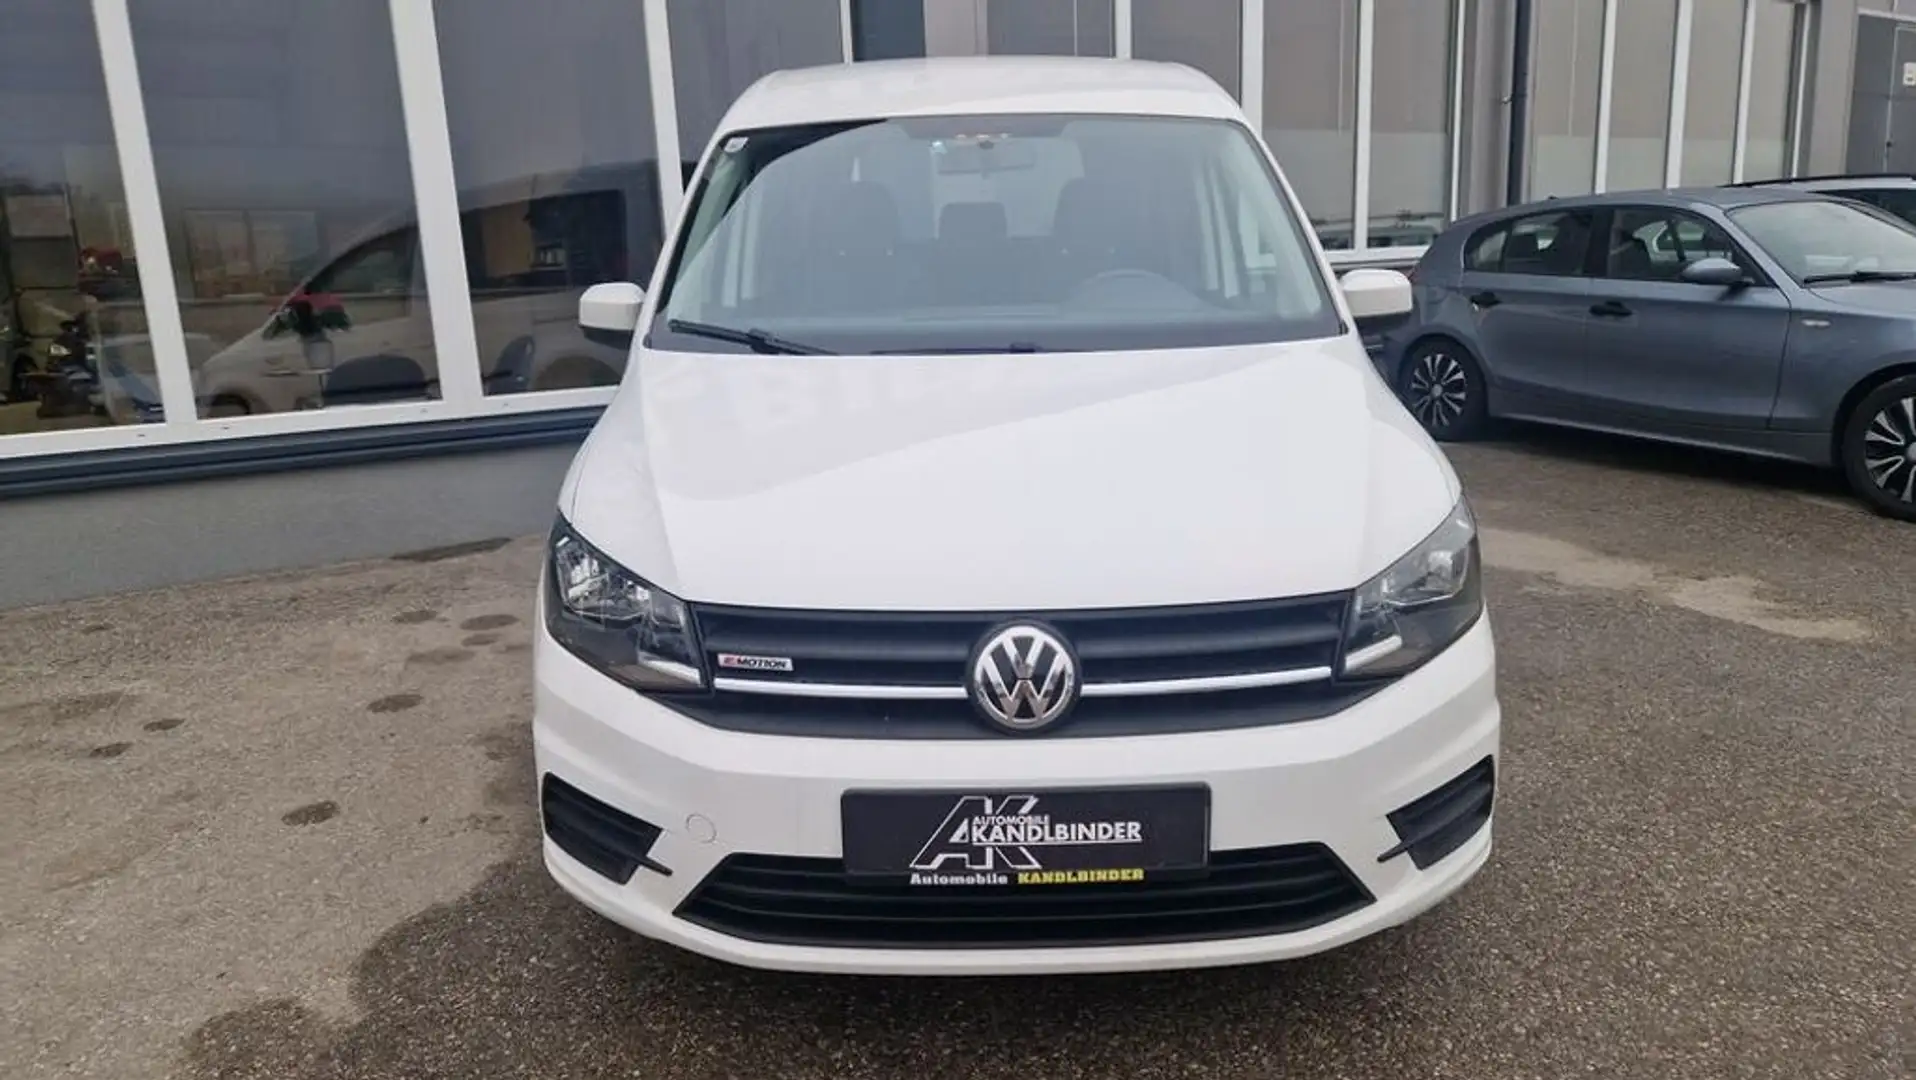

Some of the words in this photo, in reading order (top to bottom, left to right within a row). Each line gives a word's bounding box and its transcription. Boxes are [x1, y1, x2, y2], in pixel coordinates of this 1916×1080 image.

[972, 821, 1142, 843] KANDLBINDER
[910, 873, 1008, 885] Automobile
[1018, 868, 1144, 884] KANDLBINDER
